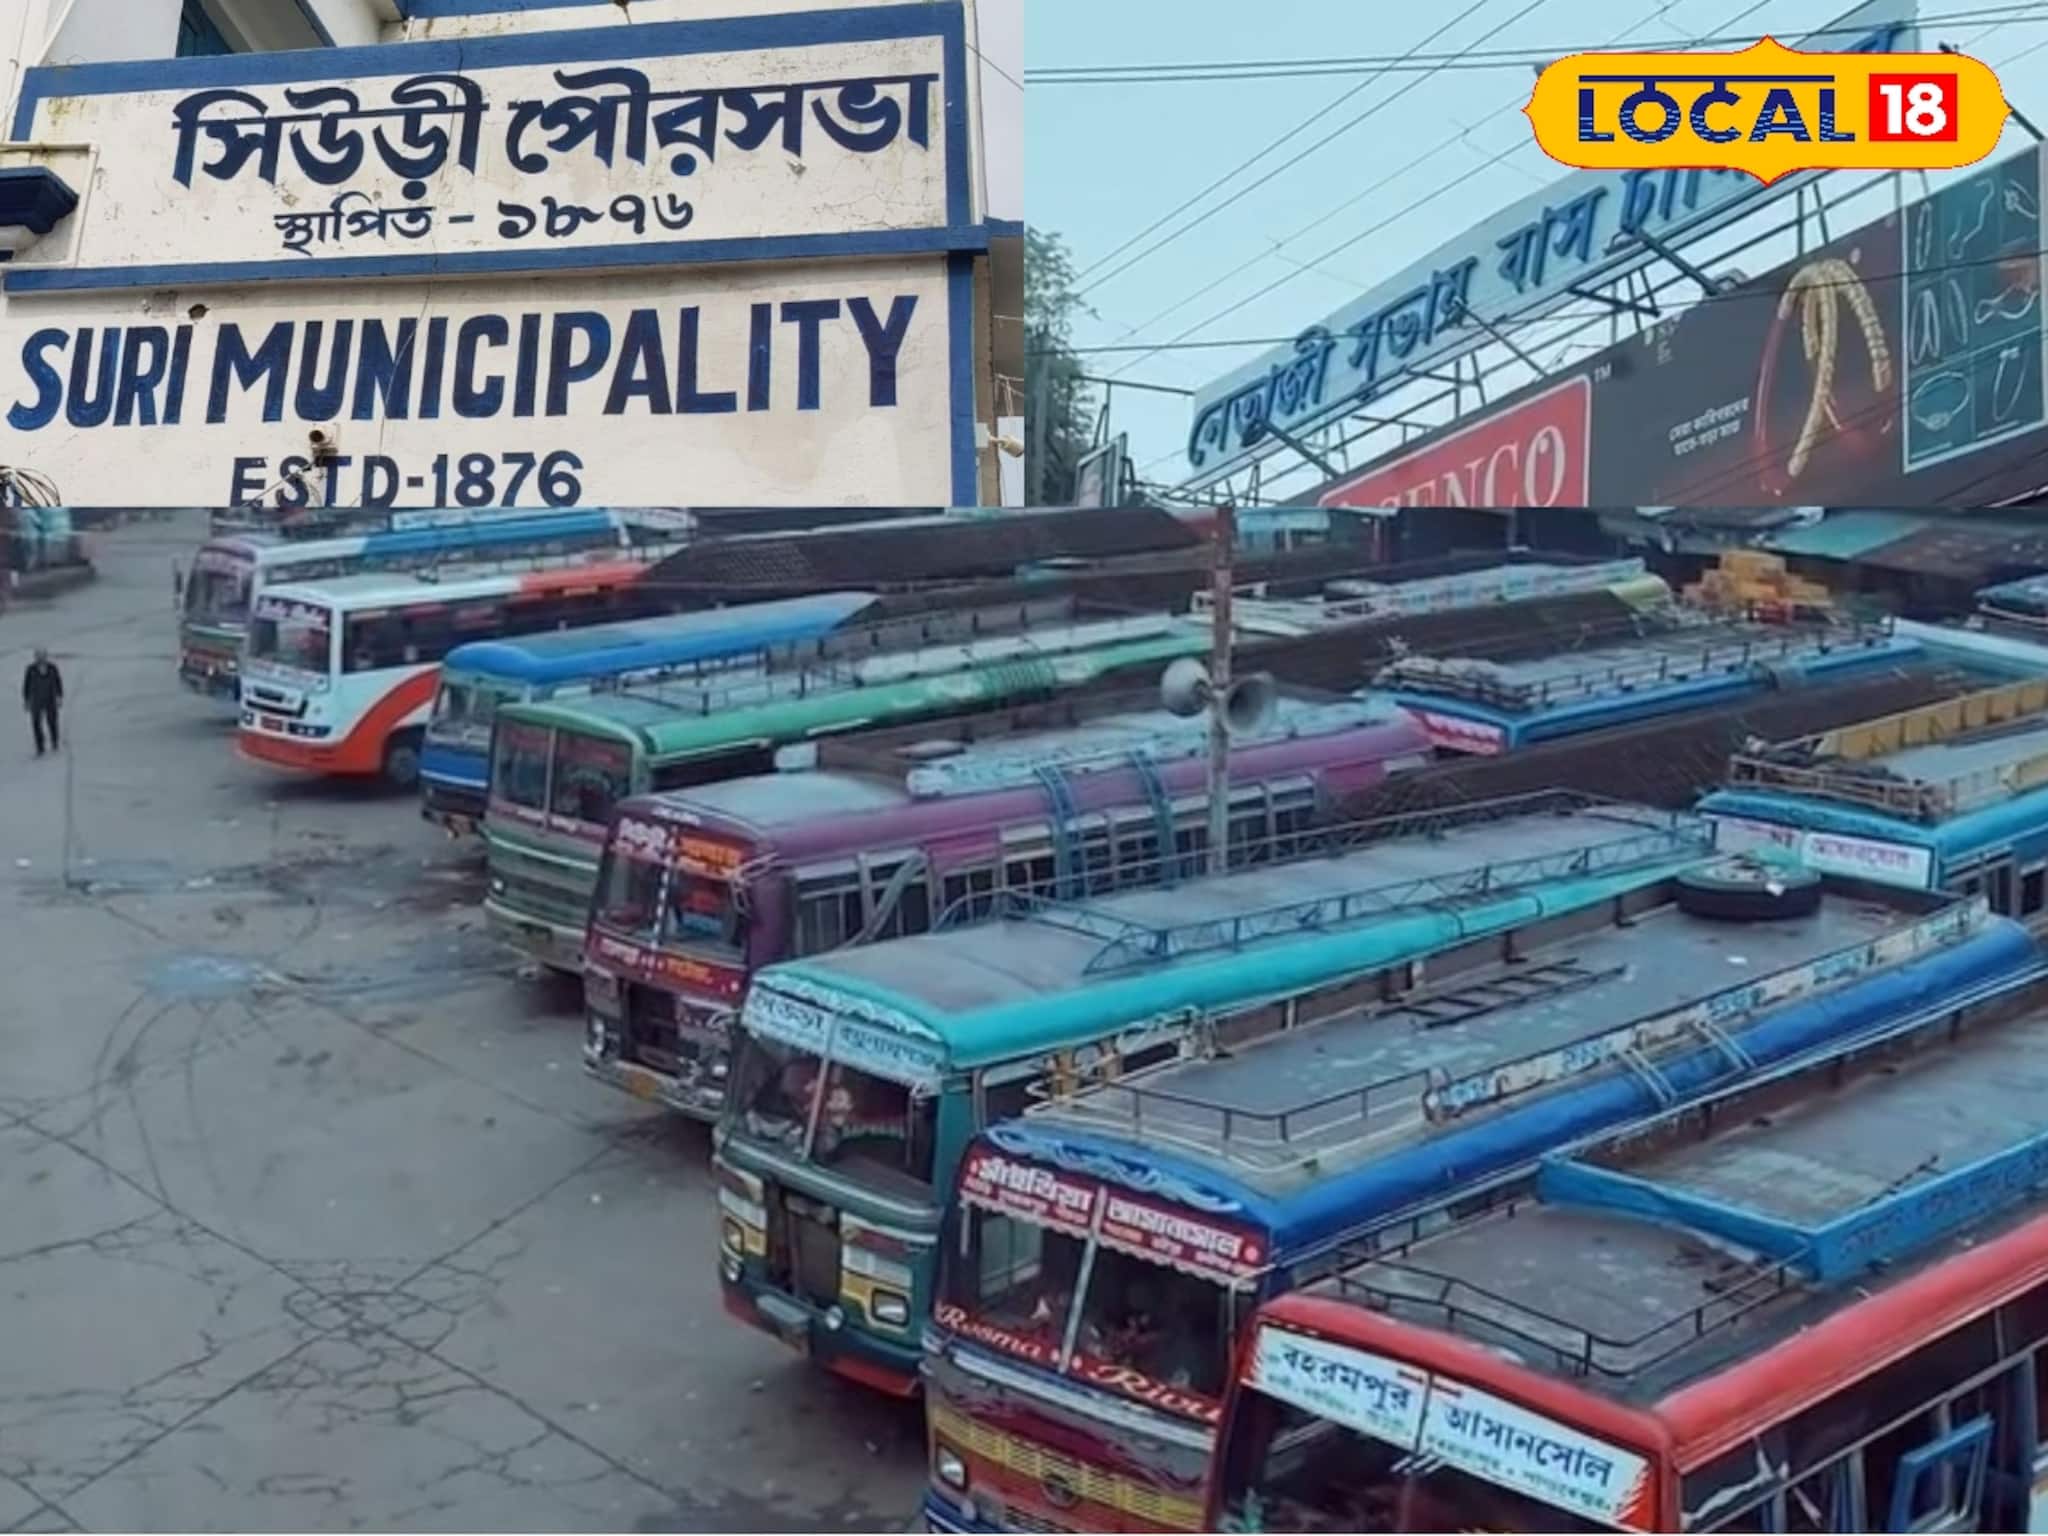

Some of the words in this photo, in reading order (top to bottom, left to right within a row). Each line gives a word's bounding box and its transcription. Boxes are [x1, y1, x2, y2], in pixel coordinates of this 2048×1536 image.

[171, 74, 489, 200] সিউড়ী
[505, 67, 940, 176] পৌরসভা
[274, 190, 437, 257] স্থাপিত
[498, 193, 694, 238] ১৮৭৬
[1496, 185, 1608, 293] বাস
[6, 324, 194, 431] SURI
[205, 295, 919, 424] MUNICIPALITY
[1281, 1342, 1412, 1412] বহরমপুর
[1444, 1400, 1615, 1488] আসানসোল
